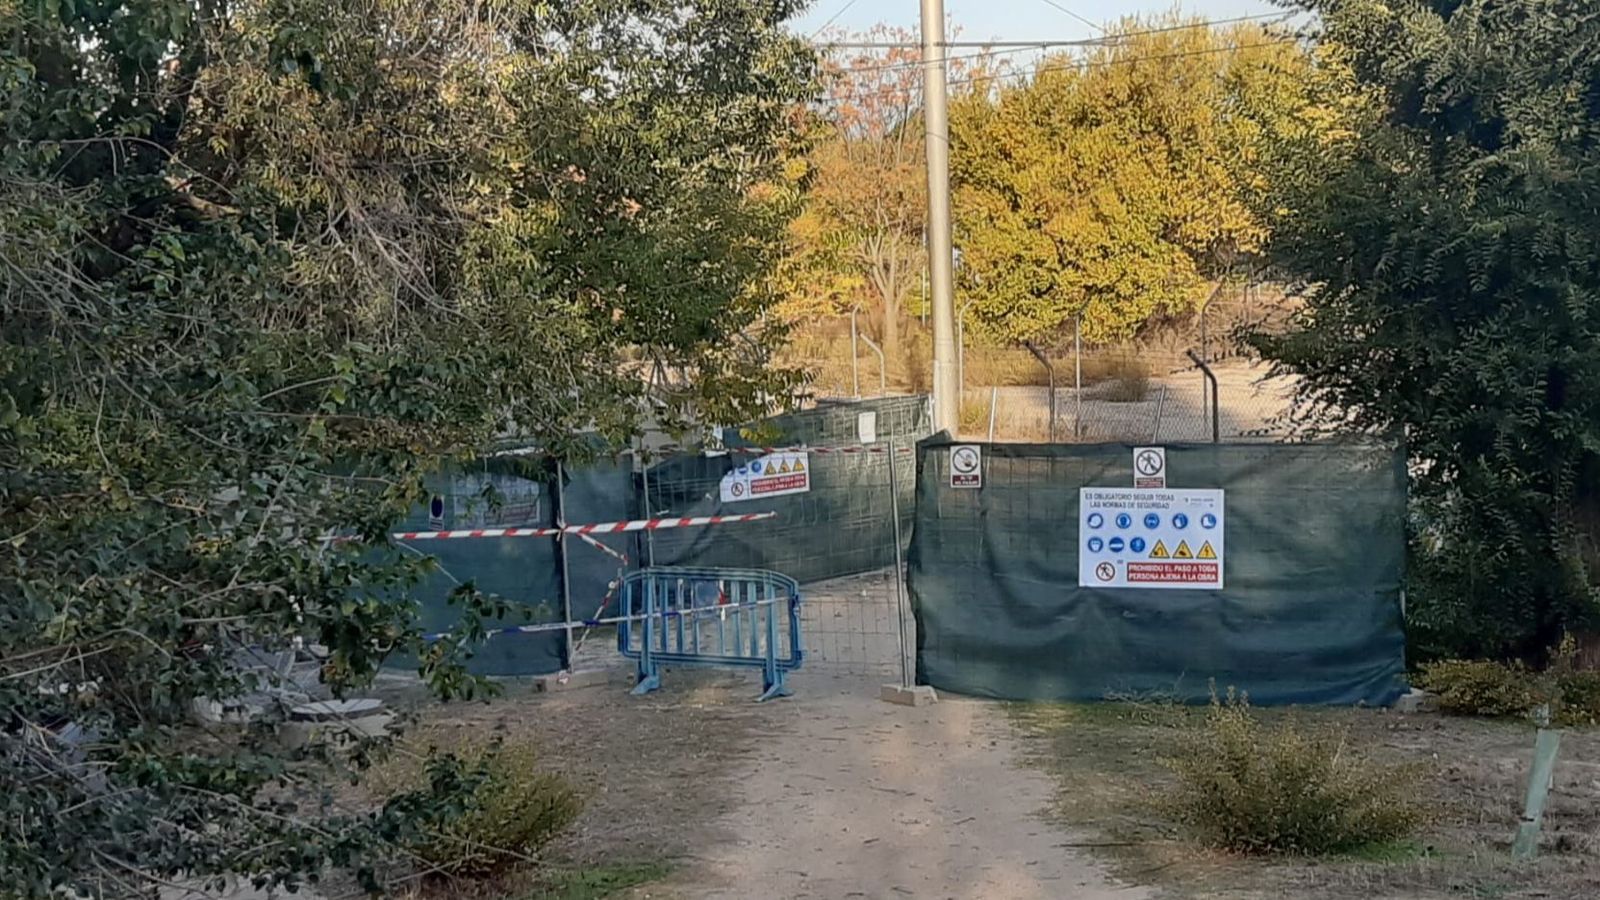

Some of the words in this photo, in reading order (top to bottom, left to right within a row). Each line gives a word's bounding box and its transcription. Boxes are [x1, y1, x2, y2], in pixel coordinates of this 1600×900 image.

[1127, 501, 1135, 509] DE
[1136, 501, 1170, 509] SEGURIDAD
[1128, 572, 1160, 580] PERSONA
[1160, 572, 1181, 580] AJENA
[1187, 572, 1197, 580] LA
[1197, 572, 1217, 580] OBRA
